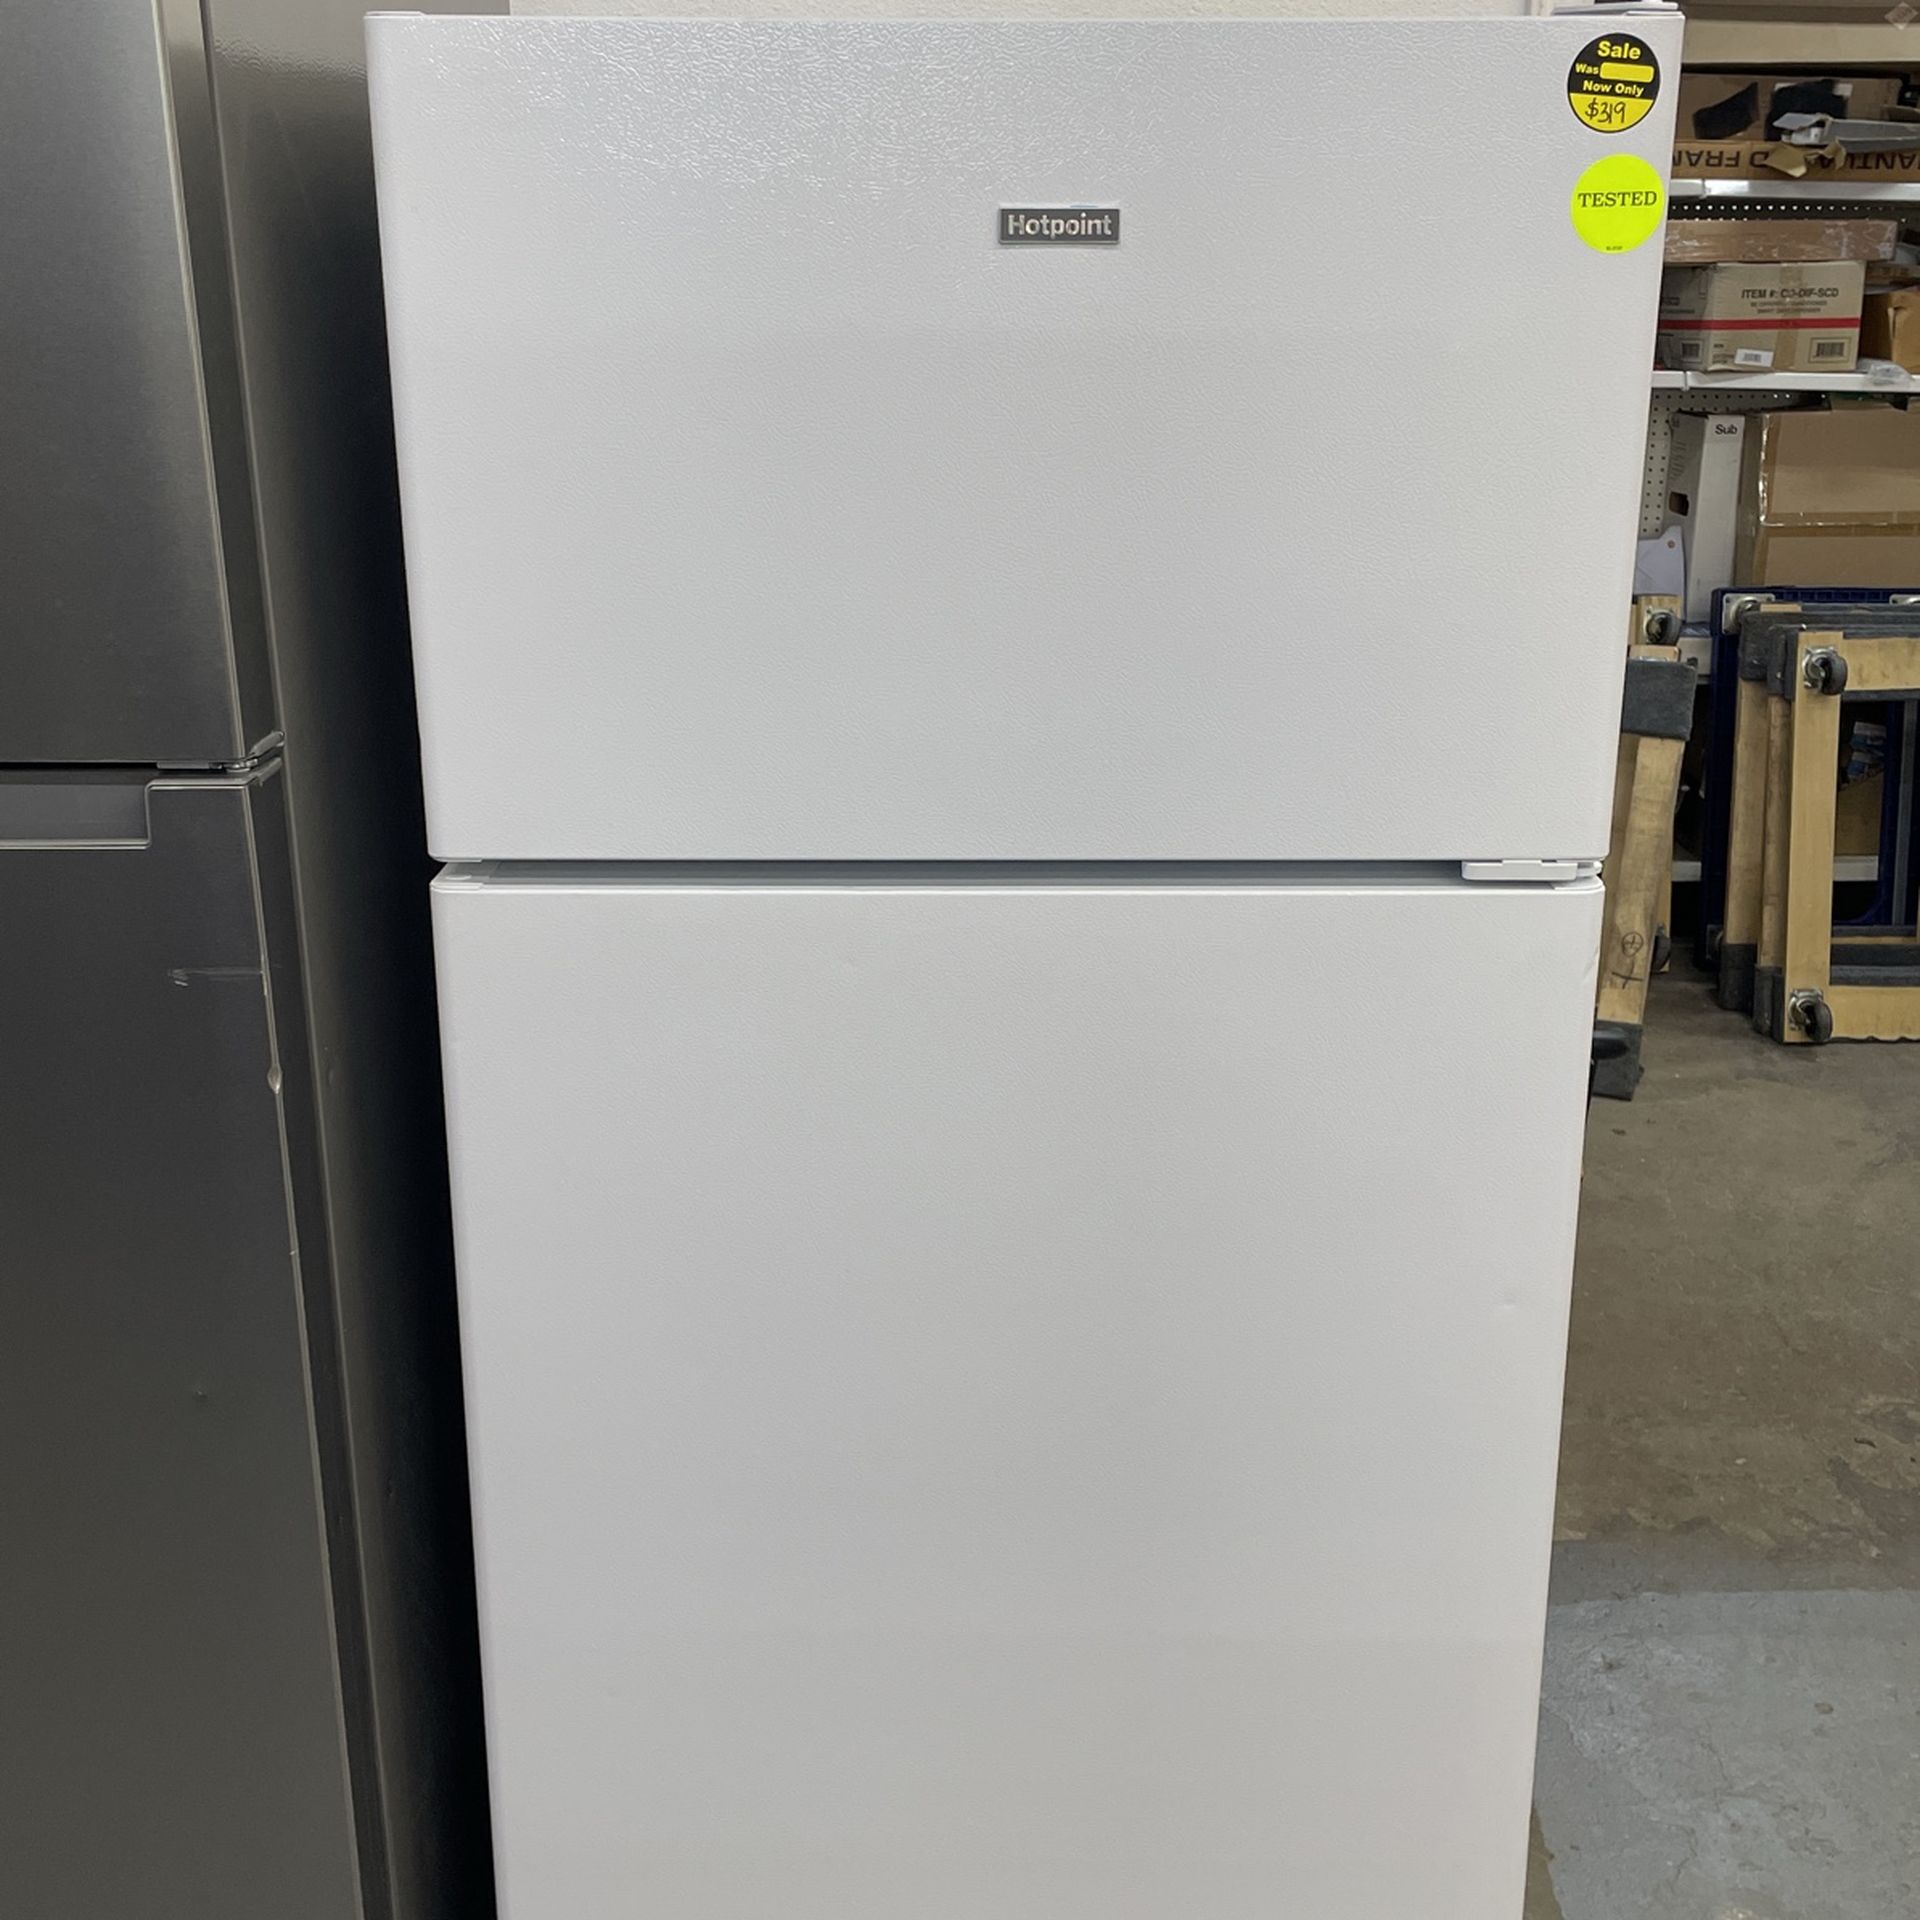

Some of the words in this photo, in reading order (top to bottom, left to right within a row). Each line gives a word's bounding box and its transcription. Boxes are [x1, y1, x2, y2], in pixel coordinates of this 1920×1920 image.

[1597, 40, 1641, 60] Sale
[1575, 63, 1599, 75] Was
[1583, 80, 1612, 93] Now
[1614, 83, 1644, 97] Only
[1585, 97, 1626, 124] $319
[1578, 191, 1657, 208] TESTED
[1008, 212, 1112, 239] Hotpoint
[1741, 288, 1767, 299] ITEM
[1715, 424, 1738, 435] Sub
